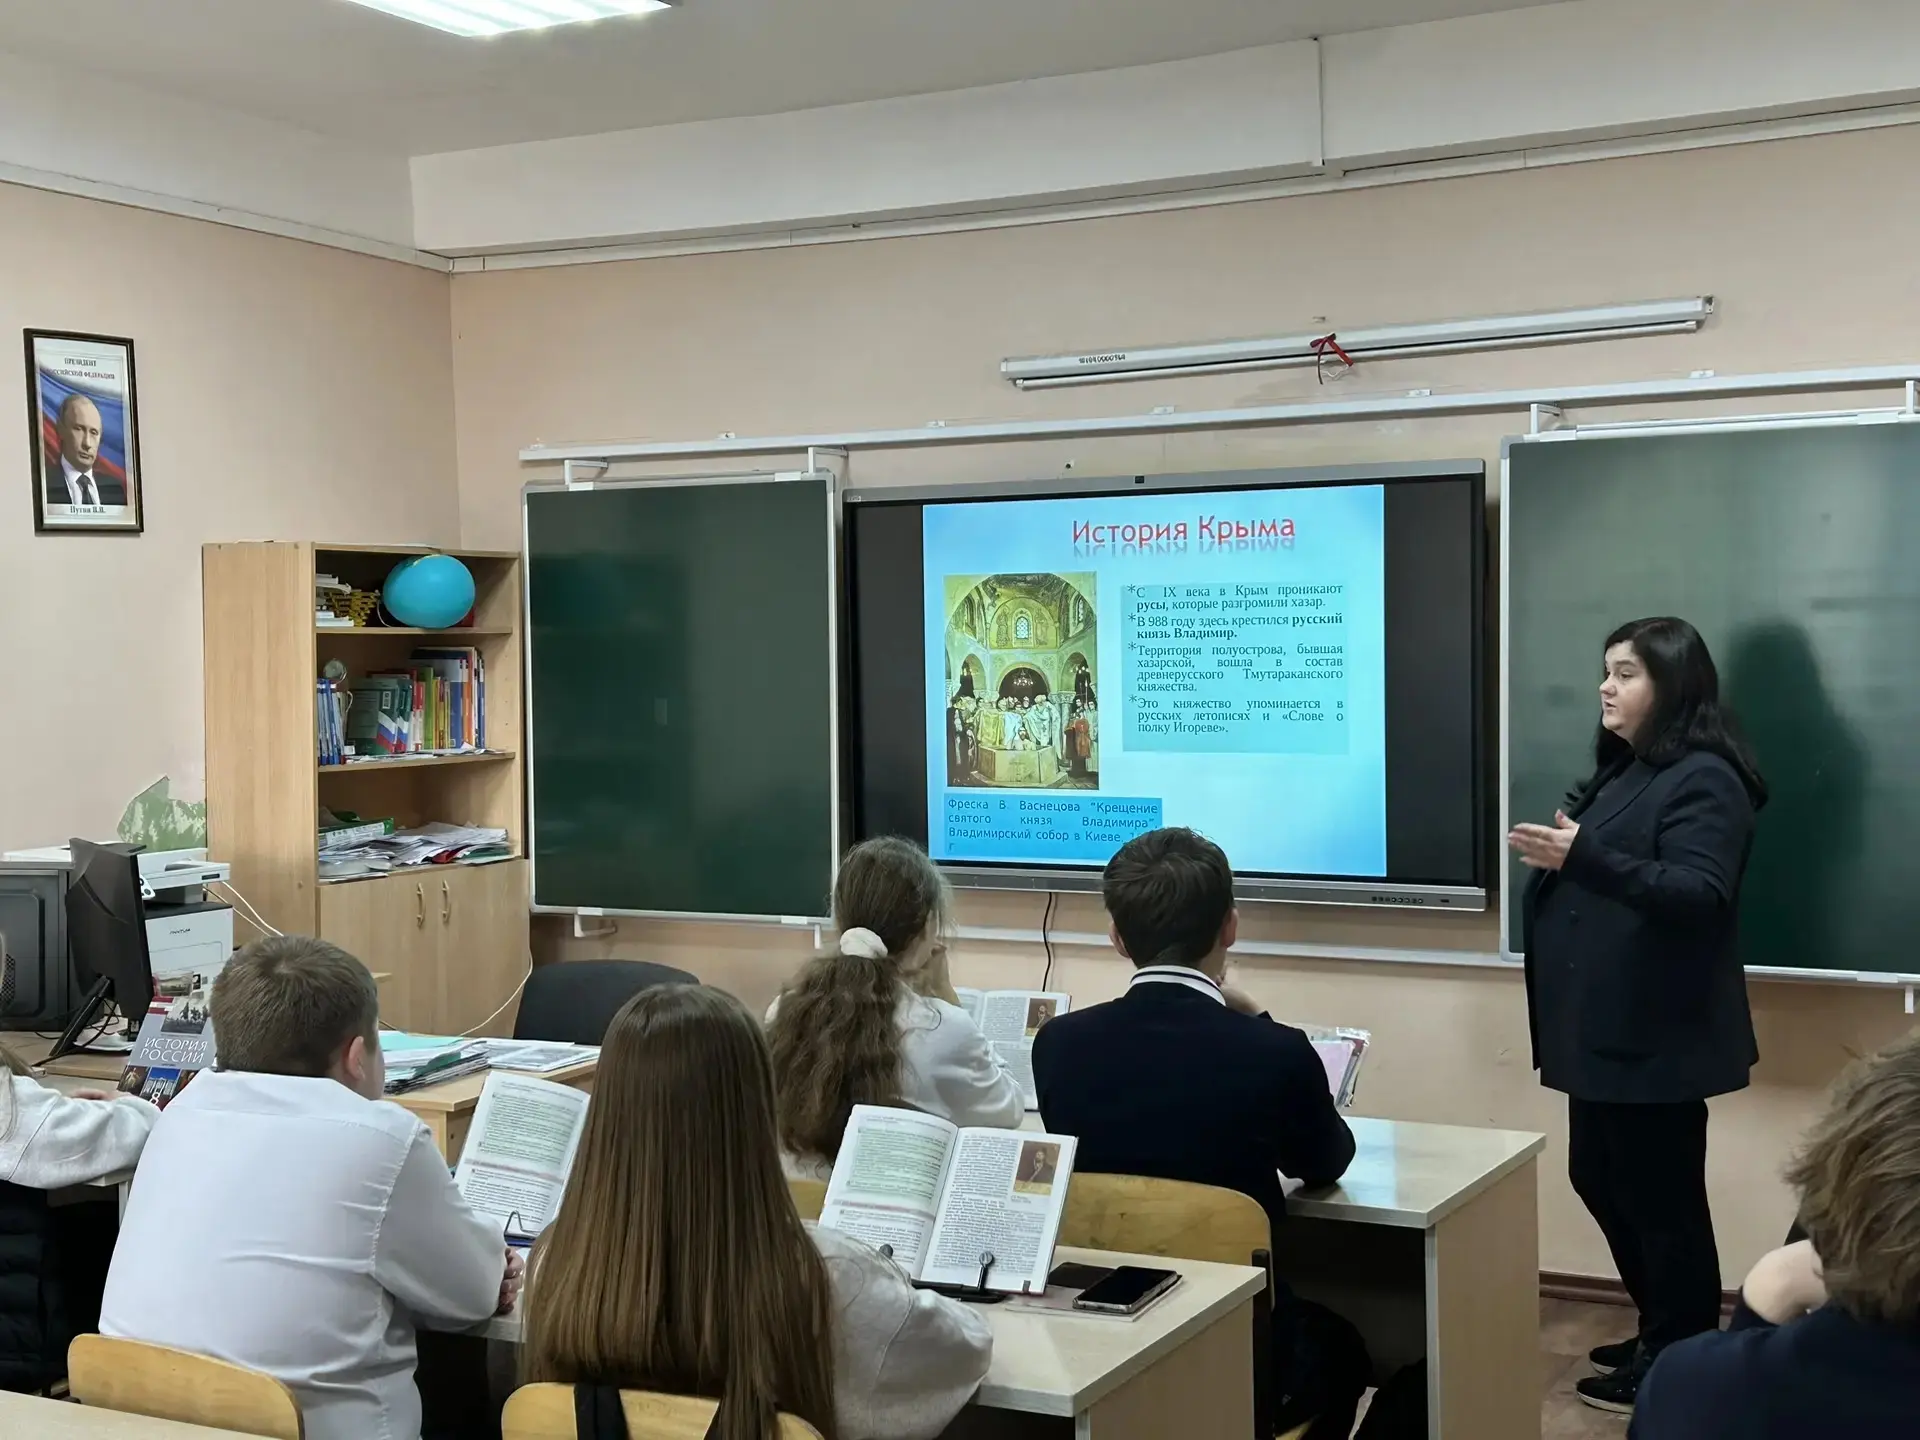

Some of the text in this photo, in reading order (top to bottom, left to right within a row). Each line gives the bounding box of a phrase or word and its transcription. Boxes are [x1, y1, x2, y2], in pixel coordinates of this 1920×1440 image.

[70, 505, 106, 515] Путин В.В.
[1073, 515, 1296, 548] История Крыма
[1136, 584, 1343, 598] С IX века в Крым проникают
[1137, 598, 1326, 613] русы, которые разгромили хазар.
[1137, 613, 1343, 629] В 988 году здесь крестился русский
[1137, 628, 1238, 640] князь Владимир.
[1137, 643, 1343, 659] Территория полуострова, бывшая
[1137, 657, 1343, 671] хазарской, вошла в состав
[1137, 668, 1343, 682] древнерусского Тмутараканского
[1137, 682, 1198, 692] княжества.
[1137, 698, 1344, 711] Это княжество упоминается в
[1138, 710, 1344, 723] русских летописях и «Слове о
[1138, 721, 1229, 735] полку Игореве».
[949, 799, 989, 811] Фреска
[1019, 800, 1081, 813] Васнецова
[949, 815, 992, 824] святого
[1020, 816, 1053, 826] князя
[949, 827, 1032, 841] Владимирский
[1036, 829, 1069, 842] собор
[1074, 832, 1081, 841] в
[144, 1037, 208, 1051] ИСТОРИЯ
[139, 1048, 205, 1064] РОССИИ
